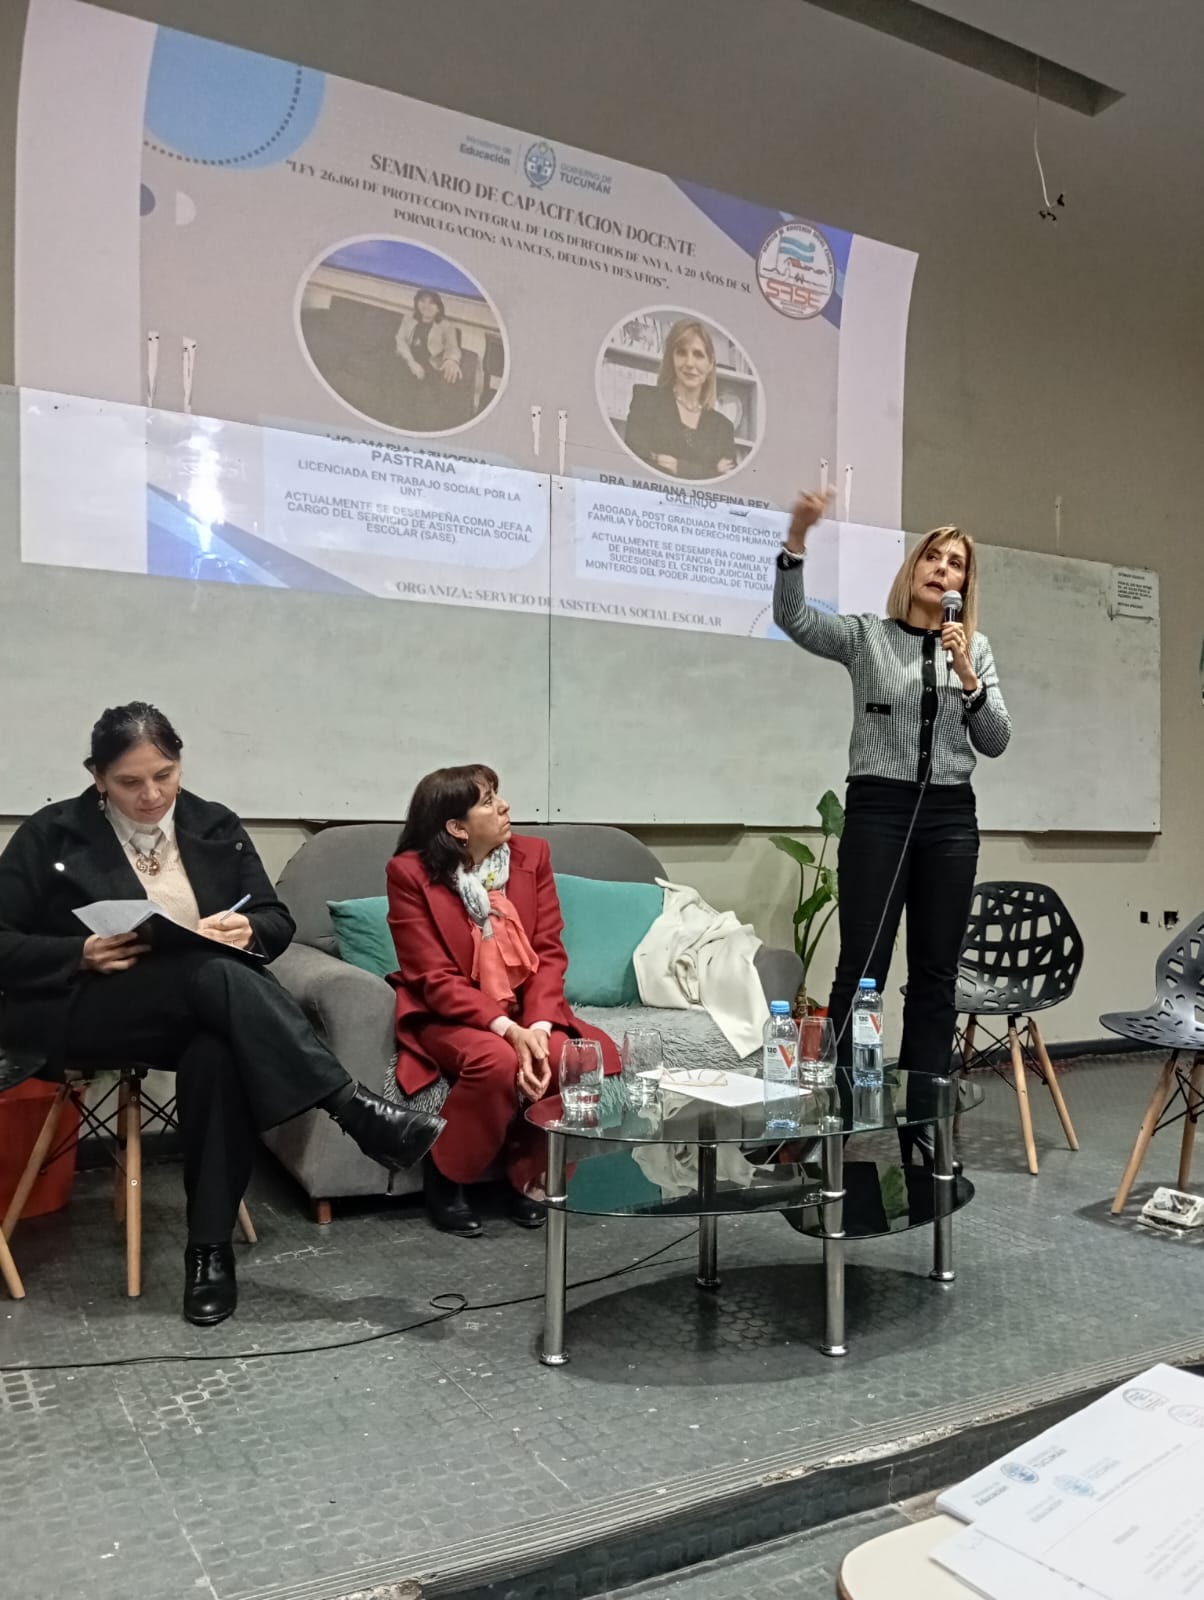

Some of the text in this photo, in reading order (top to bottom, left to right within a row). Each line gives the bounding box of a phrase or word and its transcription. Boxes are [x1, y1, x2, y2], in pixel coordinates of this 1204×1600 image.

[459, 143, 511, 166] Educación
[560, 172, 612, 195] TUCUMÁN
[370, 153, 697, 257] SEMINARIO DE CAPACITACION DOCENTE
[362, 180, 379, 193] DE
[382, 184, 462, 215] PROTECCION
[464, 207, 522, 232] INTEGRAL
[526, 224, 541, 236] DE
[543, 227, 565, 243] LOS
[567, 234, 624, 259] DERECHOS
[626, 250, 641, 263] DE
[676, 265, 682, 275] A
[685, 267, 697, 278] 20
[700, 269, 725, 286] AÑOS
[726, 277, 738, 289] DE
[557, 251, 602, 272] DEUDAS
[602, 262, 609, 273] Y
[371, 450, 456, 474] PASTRANA
[298, 459, 521, 501] LICENCIADA EN TRABAJO SOCIAL POR LA
[599, 474, 628, 487] DRA.
[632, 479, 686, 497] MARIANA
[748, 499, 771, 510] REY
[285, 490, 533, 533] ACTUALMENTE SE DESEMPEÑA COMO JEFA A
[287, 501, 531, 543] CARGO DEL SERVICIO DE ASISTENCIA SOCIAL
[587, 511, 626, 525] FAMILIA
[628, 518, 634, 526] Y
[636, 519, 679, 533] DOCTORA
[681, 526, 693, 535] EN
[695, 528, 740, 542] DERECHOS
[642, 510, 665, 521] POST
[668, 514, 716, 529] GRADUADA
[717, 522, 729, 532] EN
[731, 524, 770, 538] DERECHO
[772, 531, 782, 540] DE
[366, 522, 418, 538] ESCOLAR
[592, 532, 660, 549] ACTUALMENTE
[662, 542, 673, 551] SE
[675, 543, 728, 558] DESEMPEÑA
[730, 552, 756, 562] COMO
[609, 543, 620, 552] DE
[623, 545, 663, 558] PRIMERA
[665, 551, 713, 565] INSTANCIA
[715, 558, 726, 567] EN
[728, 560, 762, 572] FAMILIA
[585, 559, 773, 592] MONTEROS DEL PODER JUDICIAL DE TUCUM
[609, 552, 666, 569] SUCESIONES
[680, 562, 716, 575] CENTRO
[717, 567, 754, 580] JUDICIAL
[757, 573, 768, 582] DE
[395, 581, 723, 627] ORGANIZA: SERVICIO DE ASISTENCIA SOCIAL ESCOLAR
